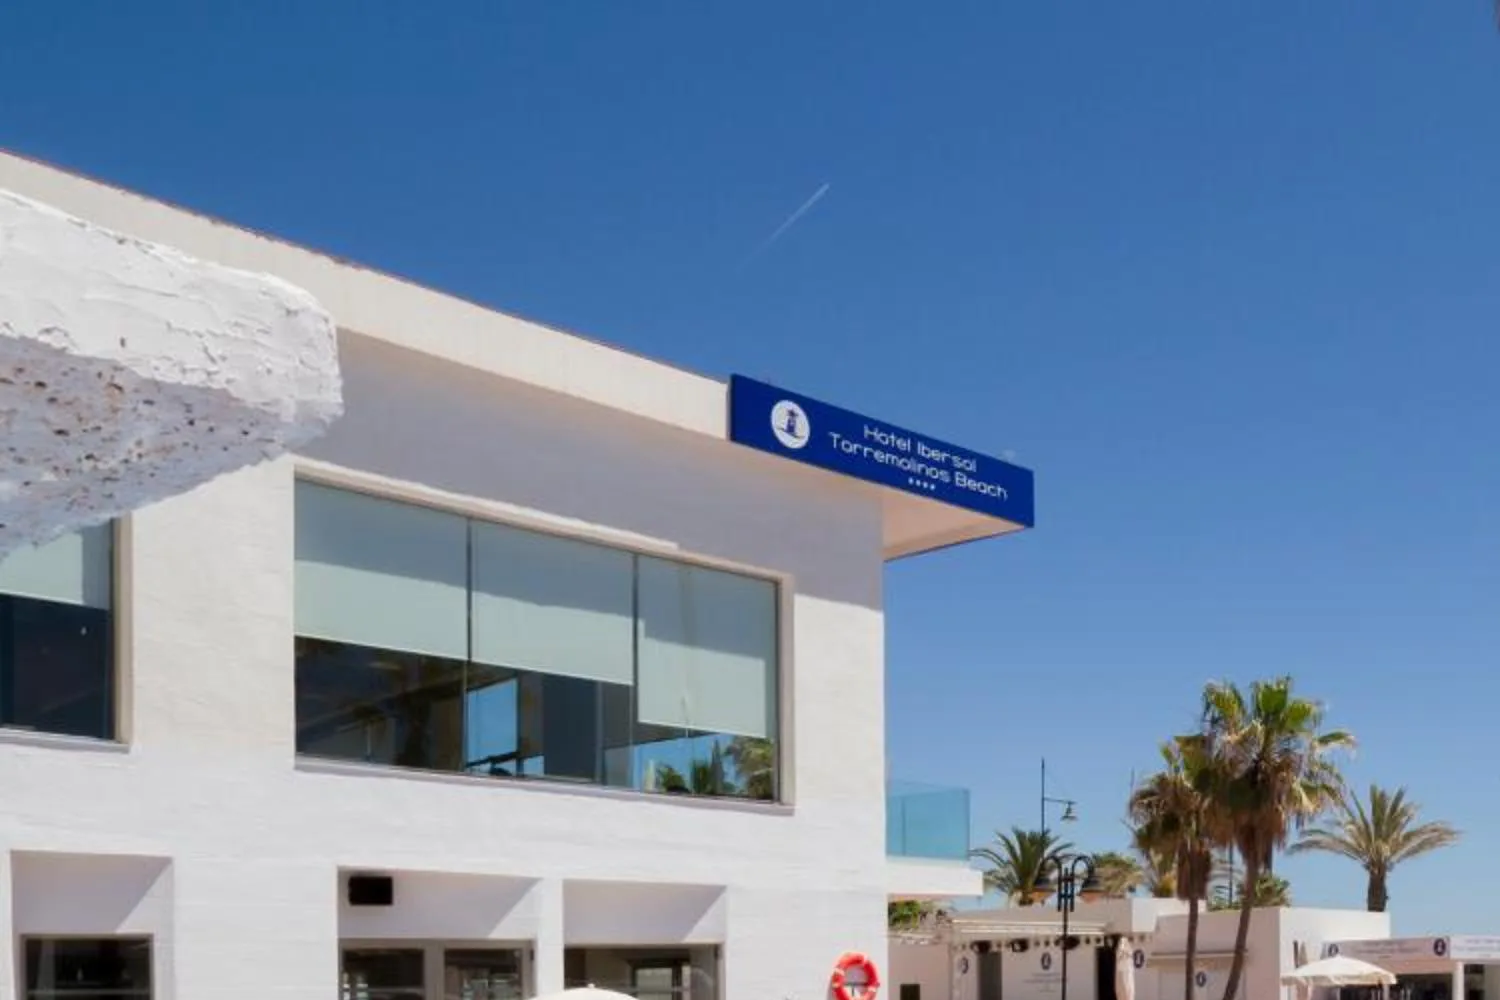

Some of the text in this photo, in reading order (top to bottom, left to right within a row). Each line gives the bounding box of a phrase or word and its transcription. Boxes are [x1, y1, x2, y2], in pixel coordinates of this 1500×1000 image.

[828, 431, 1008, 502] Torremolinos Beach
[863, 424, 977, 473] Hotel Ibersal
